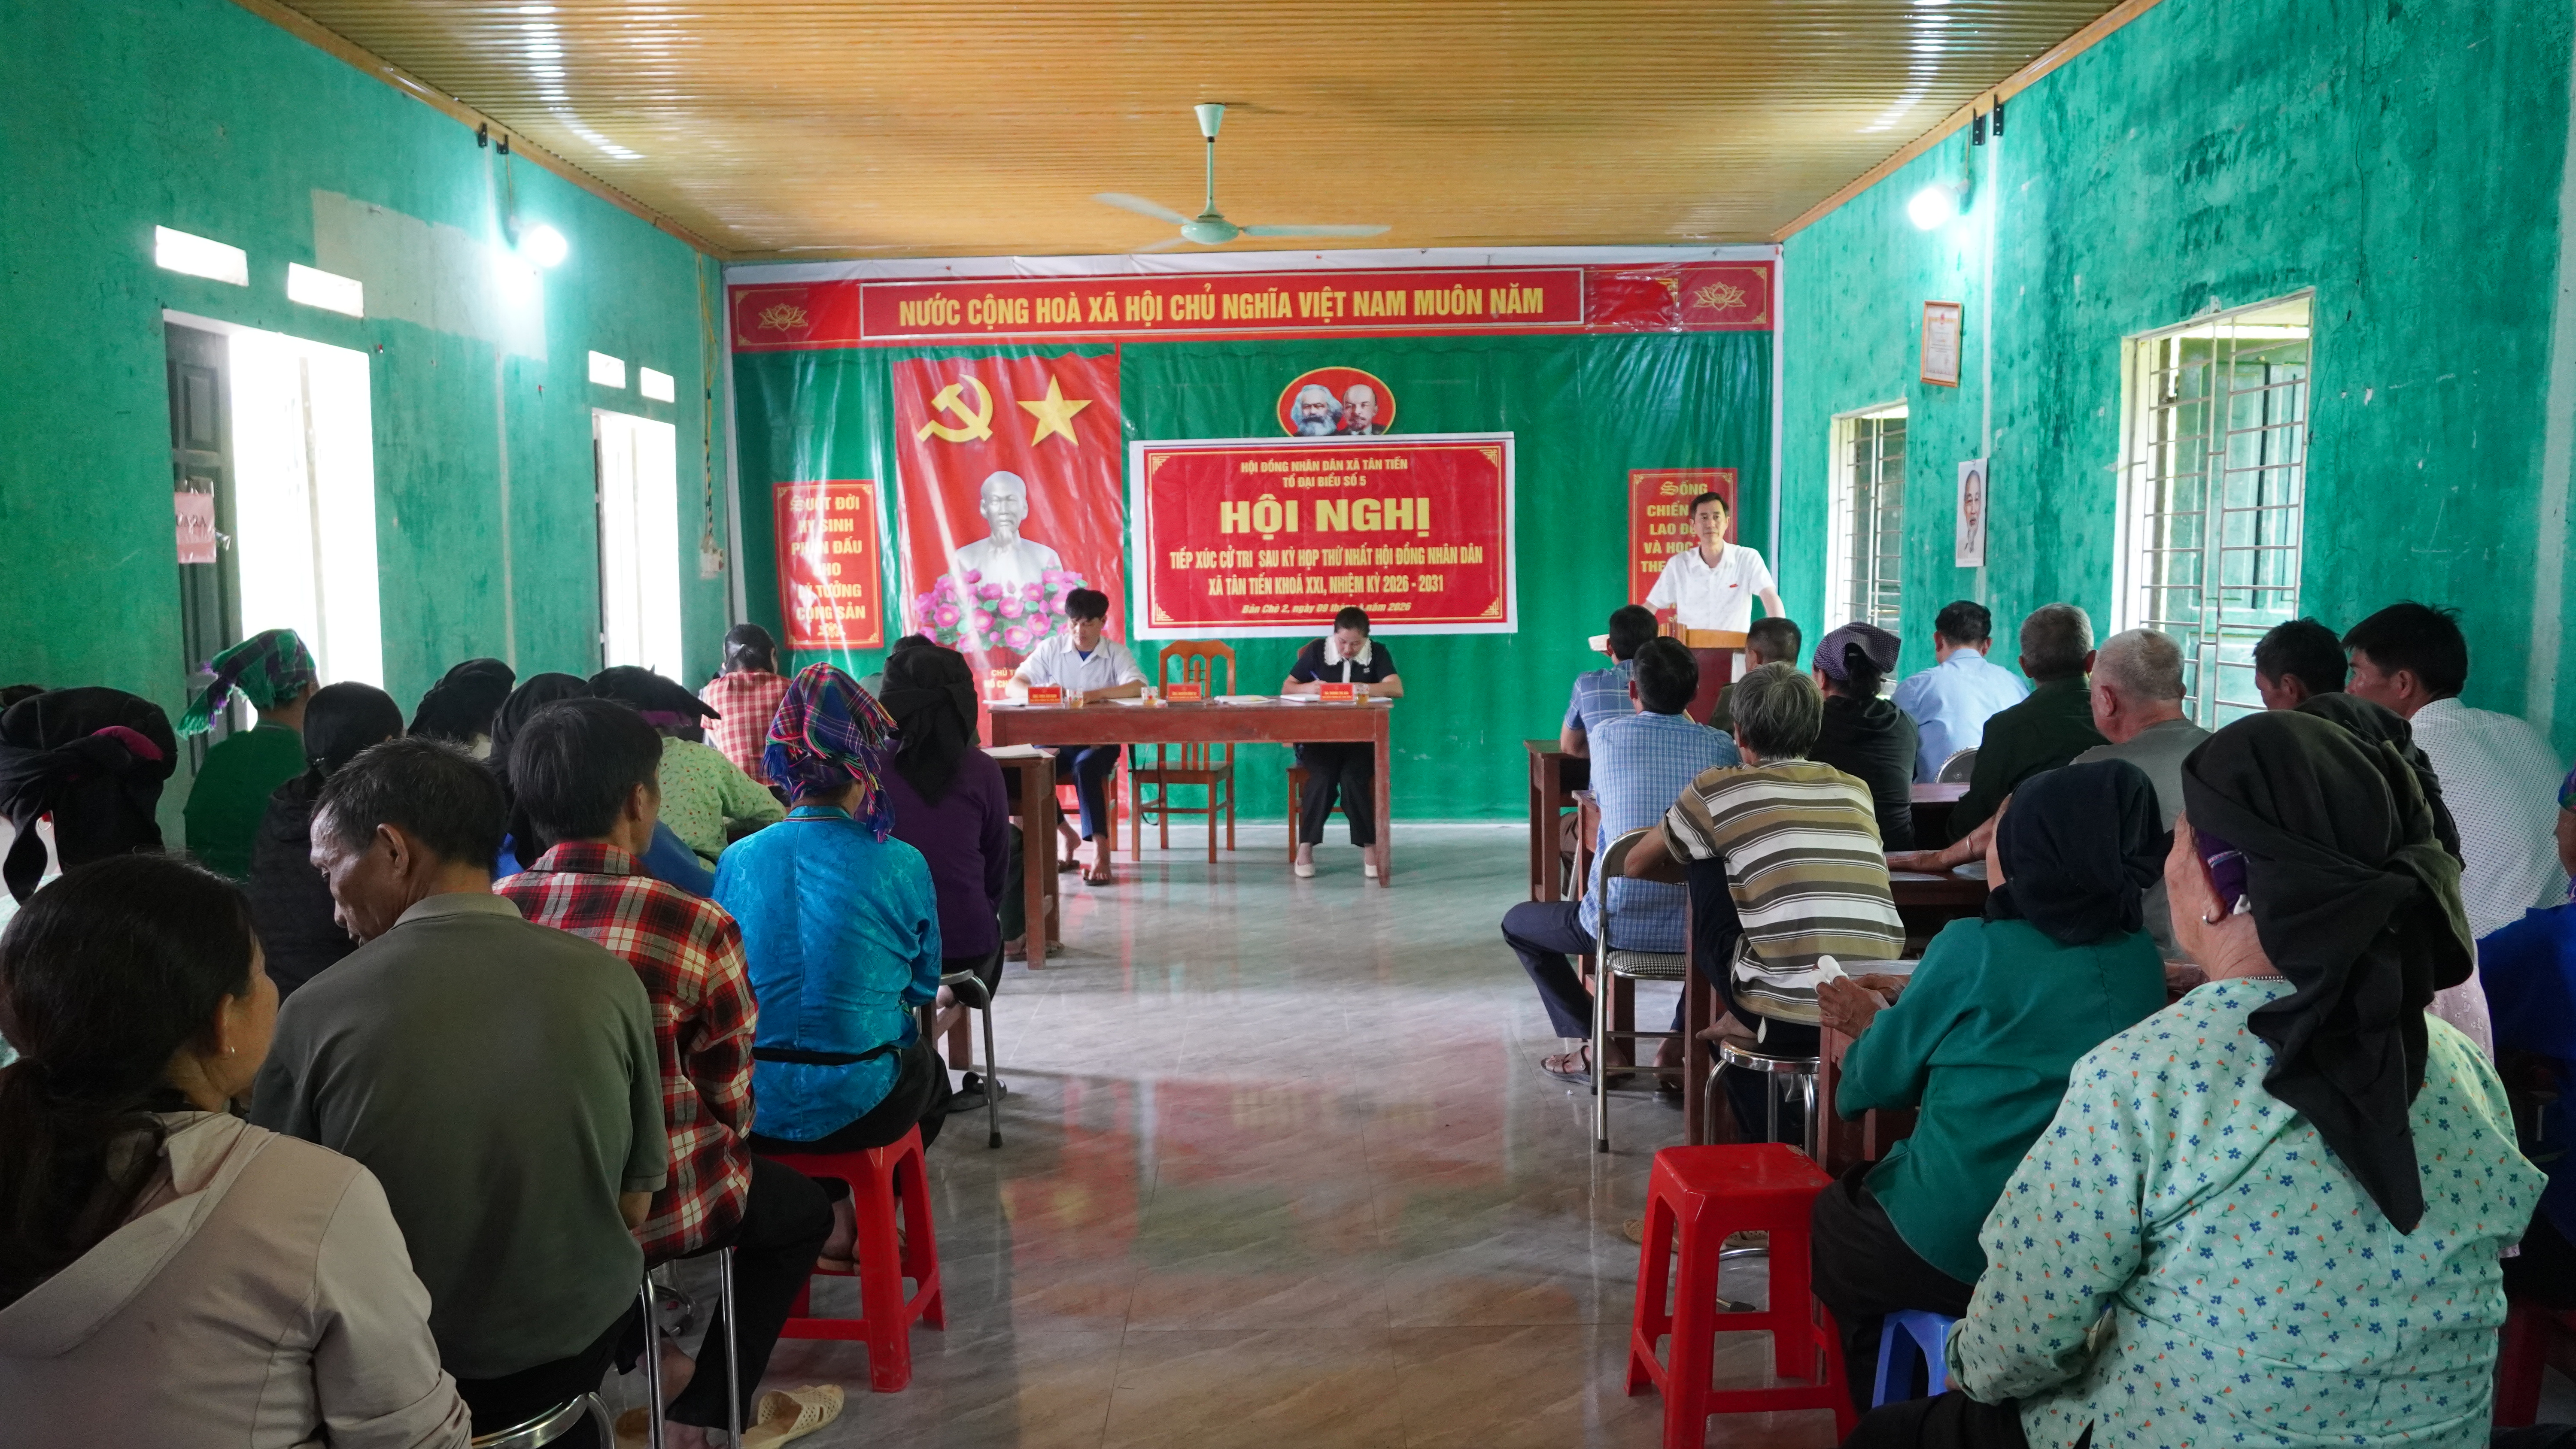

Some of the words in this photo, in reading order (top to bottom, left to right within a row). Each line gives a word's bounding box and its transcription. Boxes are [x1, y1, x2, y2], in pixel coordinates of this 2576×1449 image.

[899, 292, 960, 326] NƯỚC
[967, 294, 1029, 330] CỘNG
[1036, 292, 1082, 324] HOÀ
[1088, 291, 1119, 322] XÃ
[1126, 290, 1163, 327] HỘI
[1170, 283, 1216, 320] CHỦ
[1222, 287, 1292, 319] NGHĨA
[1298, 286, 1346, 324] VIỆT
[1353, 290, 1406, 317] NAM
[1414, 284, 1482, 316] MUÔN
[1489, 282, 1544, 314] NĂM
[1241, 460, 1258, 475] HỘI
[1261, 458, 1289, 472] ĐỒNG
[1291, 459, 1320, 471] NHÂN
[1323, 458, 1344, 471] DÂN
[1346, 458, 1361, 470] XÃ
[1363, 457, 1383, 470] TÂN
[1385, 456, 1408, 470] TIẾN
[1283, 473, 1296, 488] TỔ
[1298, 477, 1315, 489] ĐẠI
[1318, 472, 1341, 487] BIỂU
[1344, 472, 1358, 486] SỐ
[1360, 476, 1367, 486] 5
[1660, 479, 1708, 496] SỐNG
[835, 493, 860, 511] ĐỜI
[1647, 500, 1689, 517] CHIẾN
[820, 518, 854, 532] SINH
[1220, 494, 1298, 540] HỘI
[1316, 497, 1430, 537] NGHỊ
[1649, 523, 1676, 535] LAO
[833, 536, 863, 554] ĐẤU
[1643, 540, 1662, 554] VÀ
[1170, 546, 1193, 569] TIẾP
[1195, 547, 1217, 569] XÚC
[1219, 545, 1235, 568] CỬ
[1236, 550, 1253, 567] TRI
[1258, 549, 1279, 567] SAU
[1282, 546, 1296, 567] KỲ
[1298, 549, 1320, 570] HỌP
[1322, 545, 1343, 566] THỨ
[1345, 542, 1373, 565] NHẤT
[1375, 544, 1393, 569] HỘI
[1396, 541, 1425, 565] ĐỒNG
[1428, 543, 1458, 564] NHÂN
[1461, 542, 1483, 564] DÂN
[1641, 560, 1667, 573] THE
[815, 580, 862, 598] TƯỞNG
[1209, 575, 1224, 596] XÃ
[1225, 574, 1247, 595] TÂN
[1249, 572, 1273, 594] TIẾN
[1275, 573, 1304, 594] KHOÁ
[1305, 576, 1327, 596] XXI,
[1329, 572, 1364, 597] NHIỆM
[1366, 571, 1380, 593] KỲ
[1383, 575, 1410, 593] 2026
[1419, 574, 1444, 592] 2031
[837, 601, 866, 620] SẢN
[1292, 603, 1315, 614] ngày
[1316, 603, 1329, 612] 09
[1366, 602, 1387, 612] năm
[1388, 602, 1412, 612] 2026
[991, 667, 1008, 677] CHỦ
